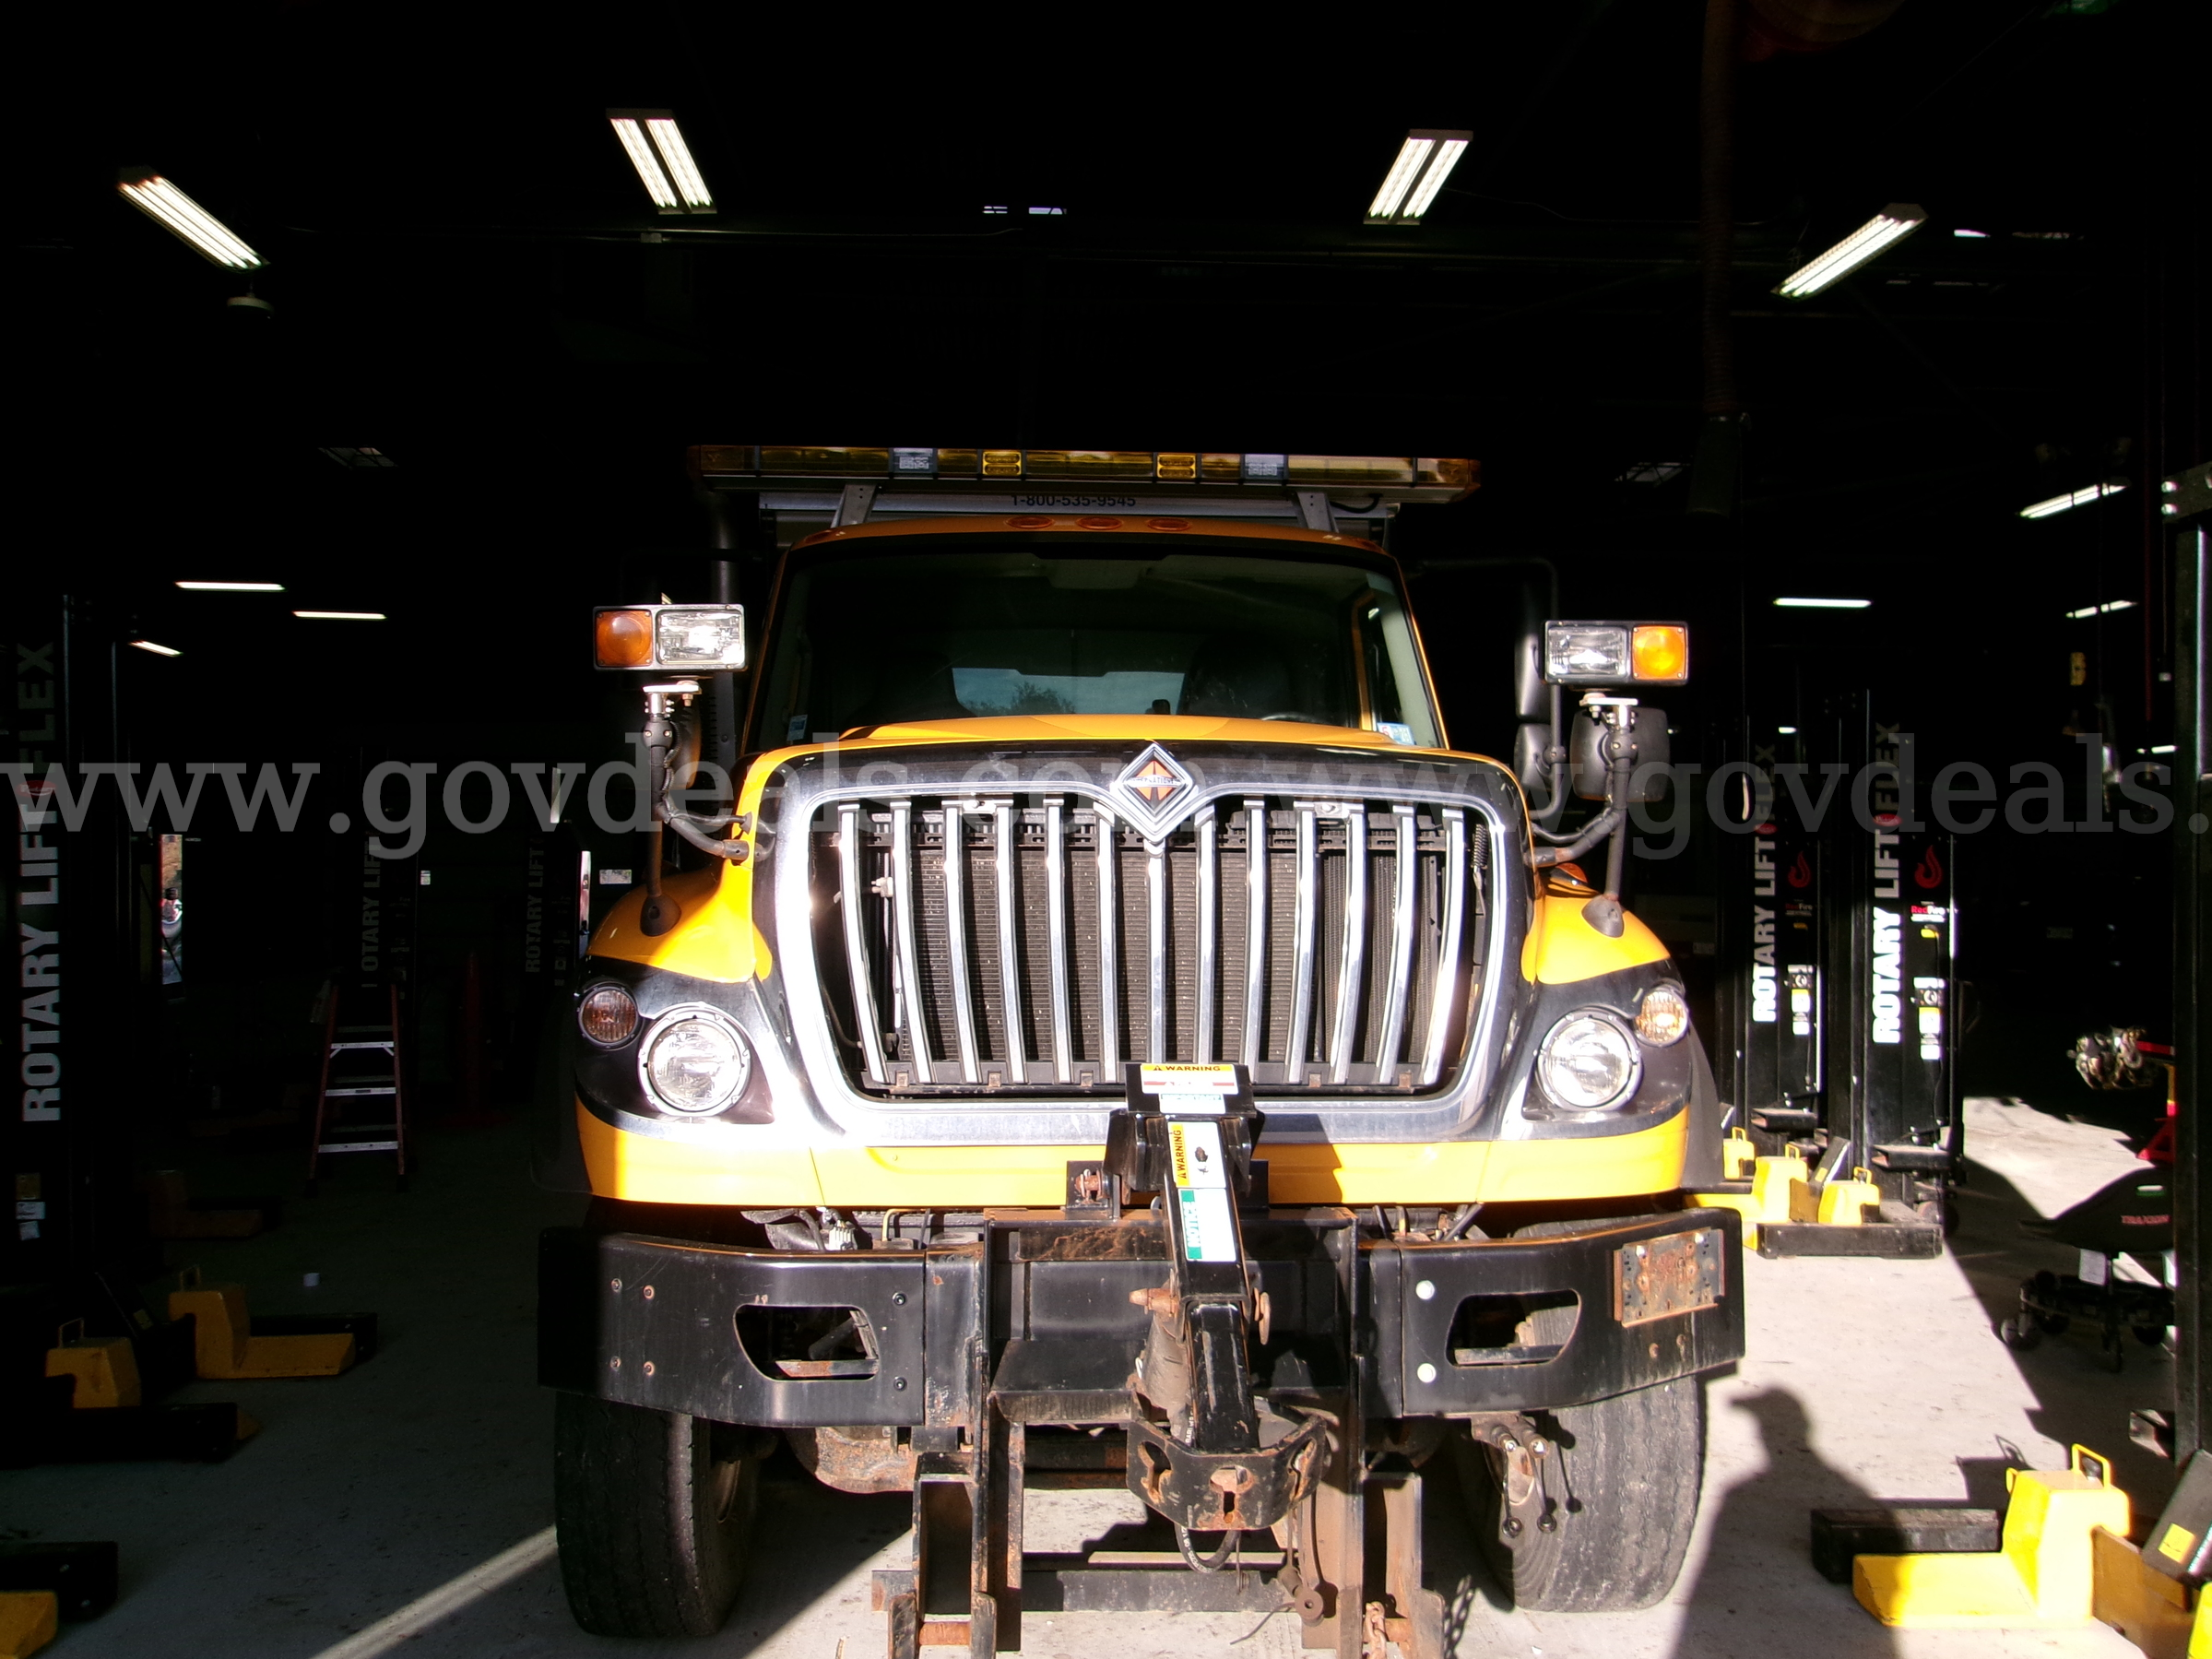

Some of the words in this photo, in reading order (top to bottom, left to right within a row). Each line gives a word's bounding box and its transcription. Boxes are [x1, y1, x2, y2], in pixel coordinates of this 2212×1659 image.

[1011, 495, 1136, 507] 1-800-535-9545
[16, 641, 56, 775] FLEX
[1875, 721, 1900, 811] FLEX
[18, 802, 59, 906] LIFT
[528, 847, 546, 889] LIFT
[1754, 836, 1776, 897] LIFT
[1874, 829, 1900, 899] LIFT
[361, 895, 381, 989] OTARY
[525, 893, 544, 973] ROTARY
[1752, 904, 1777, 1022] ROTARY
[1872, 907, 1901, 1043] ROTARY
[20, 922, 61, 1122] ROTARY
[1173, 1130, 1187, 1174] WARNING
[1182, 1201, 1201, 1248] NOTICE
